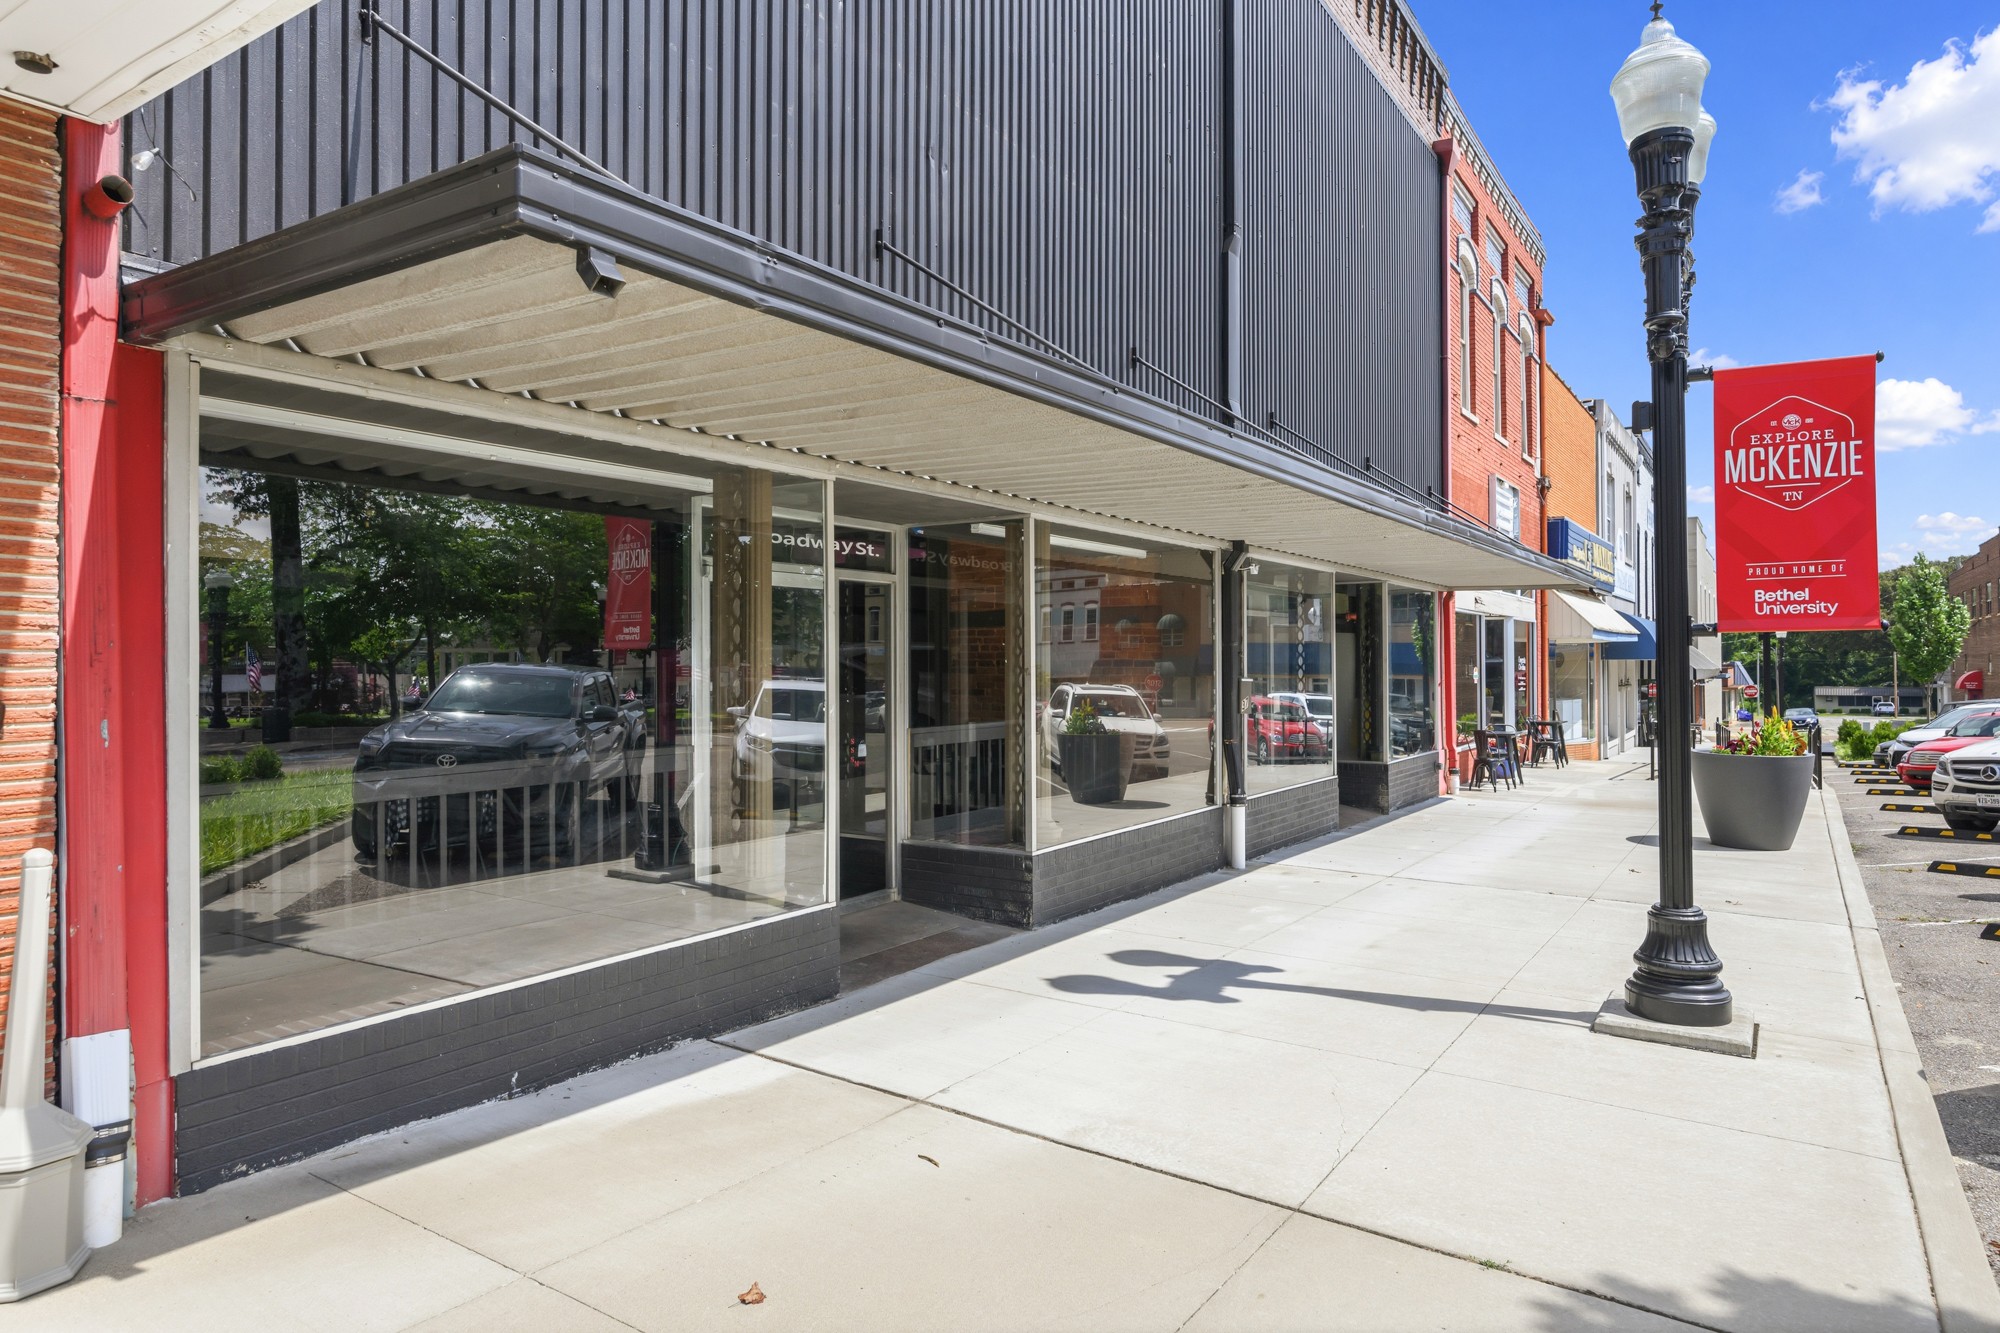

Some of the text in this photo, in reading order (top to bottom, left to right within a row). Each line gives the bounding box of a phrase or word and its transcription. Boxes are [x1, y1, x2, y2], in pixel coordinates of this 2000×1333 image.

[1750, 429, 1834, 445] EXPLORE
[1725, 440, 1863, 484] MCKENZIE
[1783, 491, 1803, 501] TN
[1748, 563, 1844, 576] PROUD HOME OF
[1754, 587, 1810, 602] Bethel
[1754, 601, 1839, 616] University
